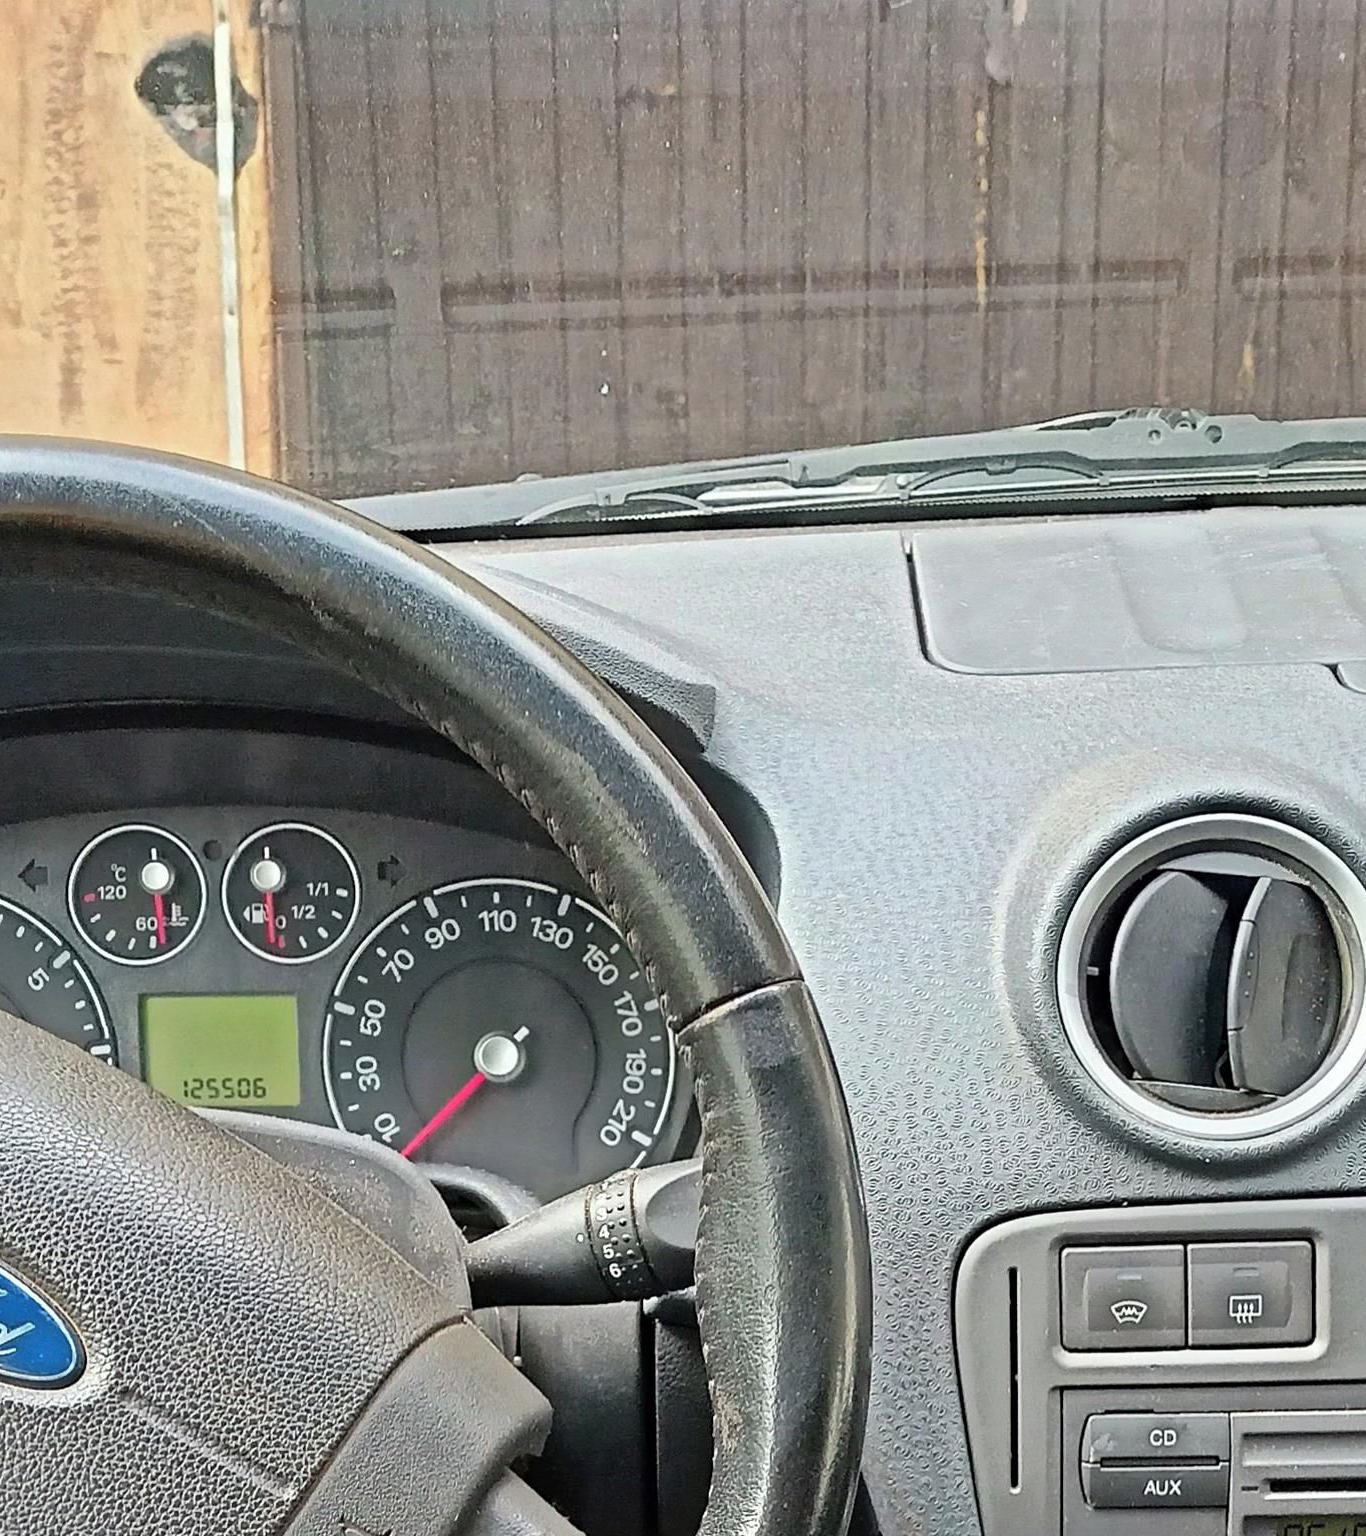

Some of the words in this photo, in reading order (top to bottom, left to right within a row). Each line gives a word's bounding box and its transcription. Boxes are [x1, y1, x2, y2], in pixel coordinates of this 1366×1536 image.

[97, 885, 127, 900] 120
[307, 882, 329, 897] 1/1
[136, 916, 158, 931] 60
[275, 915, 286, 930] 0
[291, 905, 316, 920] 1/2
[479, 909, 517, 932] 110
[424, 918, 461, 950] 90
[531, 916, 574, 949] 130
[382, 948, 415, 983] 70
[582, 944, 619, 985] 150
[27, 967, 50, 991] 5
[359, 999, 386, 1037] 50
[613, 990, 643, 1037] 170
[355, 1055, 381, 1092] 30
[622, 1048, 647, 1095] 190
[183, 1077, 267, 1100] 125506
[373, 1112, 401, 1143] 10
[600, 1098, 636, 1147] 210
[598, 1223, 610, 1239] 4
[602, 1243, 614, 1259] 5
[609, 1262, 622, 1278] 6
[1149, 1429, 1177, 1447] CD
[1143, 1479, 1182, 1496] AUX
